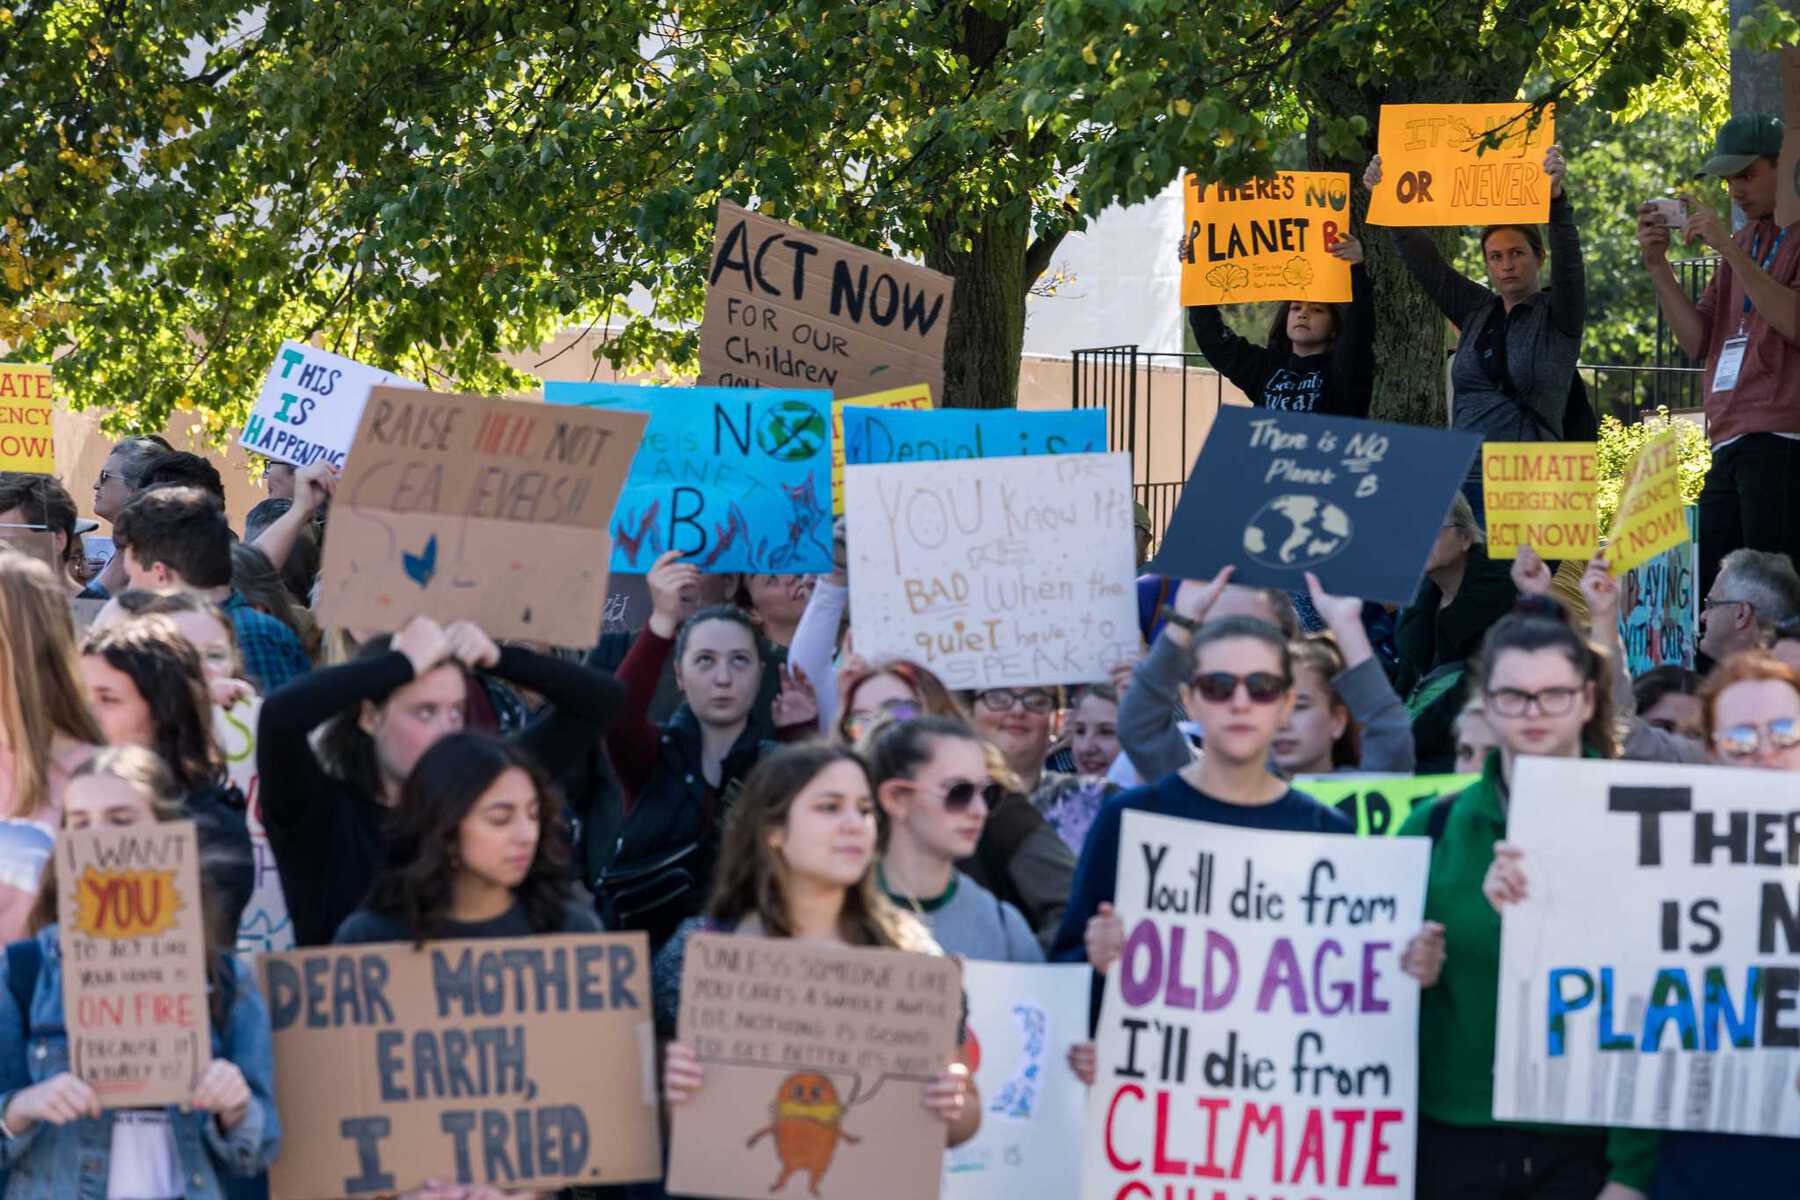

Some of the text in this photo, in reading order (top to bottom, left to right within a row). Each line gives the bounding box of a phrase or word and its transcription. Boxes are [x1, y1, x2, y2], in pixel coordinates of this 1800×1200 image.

[1304, 177, 1347, 211] NO
[1396, 162, 1540, 207] OR NEVER
[1187, 218, 1341, 264] PLANET B
[710, 220, 944, 337] ACT NOW
[727, 298, 849, 357] FOR OUR
[281, 349, 342, 396] THIS
[274, 393, 315, 425] IS
[367, 399, 464, 452] RAISE
[545, 422, 616, 467] NOT
[1249, 418, 1389, 459] There is NO
[1264, 458, 1378, 498] Planet B
[1486, 455, 1596, 482] CLIMATE
[668, 487, 706, 557] B
[1487, 491, 1596, 511] EMERGENCY
[878, 478, 984, 576] YOU
[1491, 522, 1598, 547] ACT NOW!
[904, 572, 969, 615] BAD
[1087, 570, 1126, 597] the
[1014, 622, 1065, 647] have
[1080, 612, 1116, 640] to
[945, 643, 1082, 684] SPEAK
[66, 834, 185, 873] I WANT
[88, 876, 161, 929] YOU
[1231, 859, 1284, 922] die
[1301, 859, 1397, 928] from
[1661, 900, 1722, 955] IS
[266, 944, 639, 1032] DEAR MOTHER
[800, 957, 893, 988] SOMEONE
[1120, 918, 1392, 1018] OLD AGE
[77, 991, 193, 1030] ON FIRE
[1546, 966, 1800, 1057] PLANE
[377, 1026, 537, 1101] EARTH,
[1114, 1018, 1391, 1097] I'll die from
[340, 1104, 601, 1194] I TRIED.
[1104, 1083, 1405, 1188] CLIMATE
